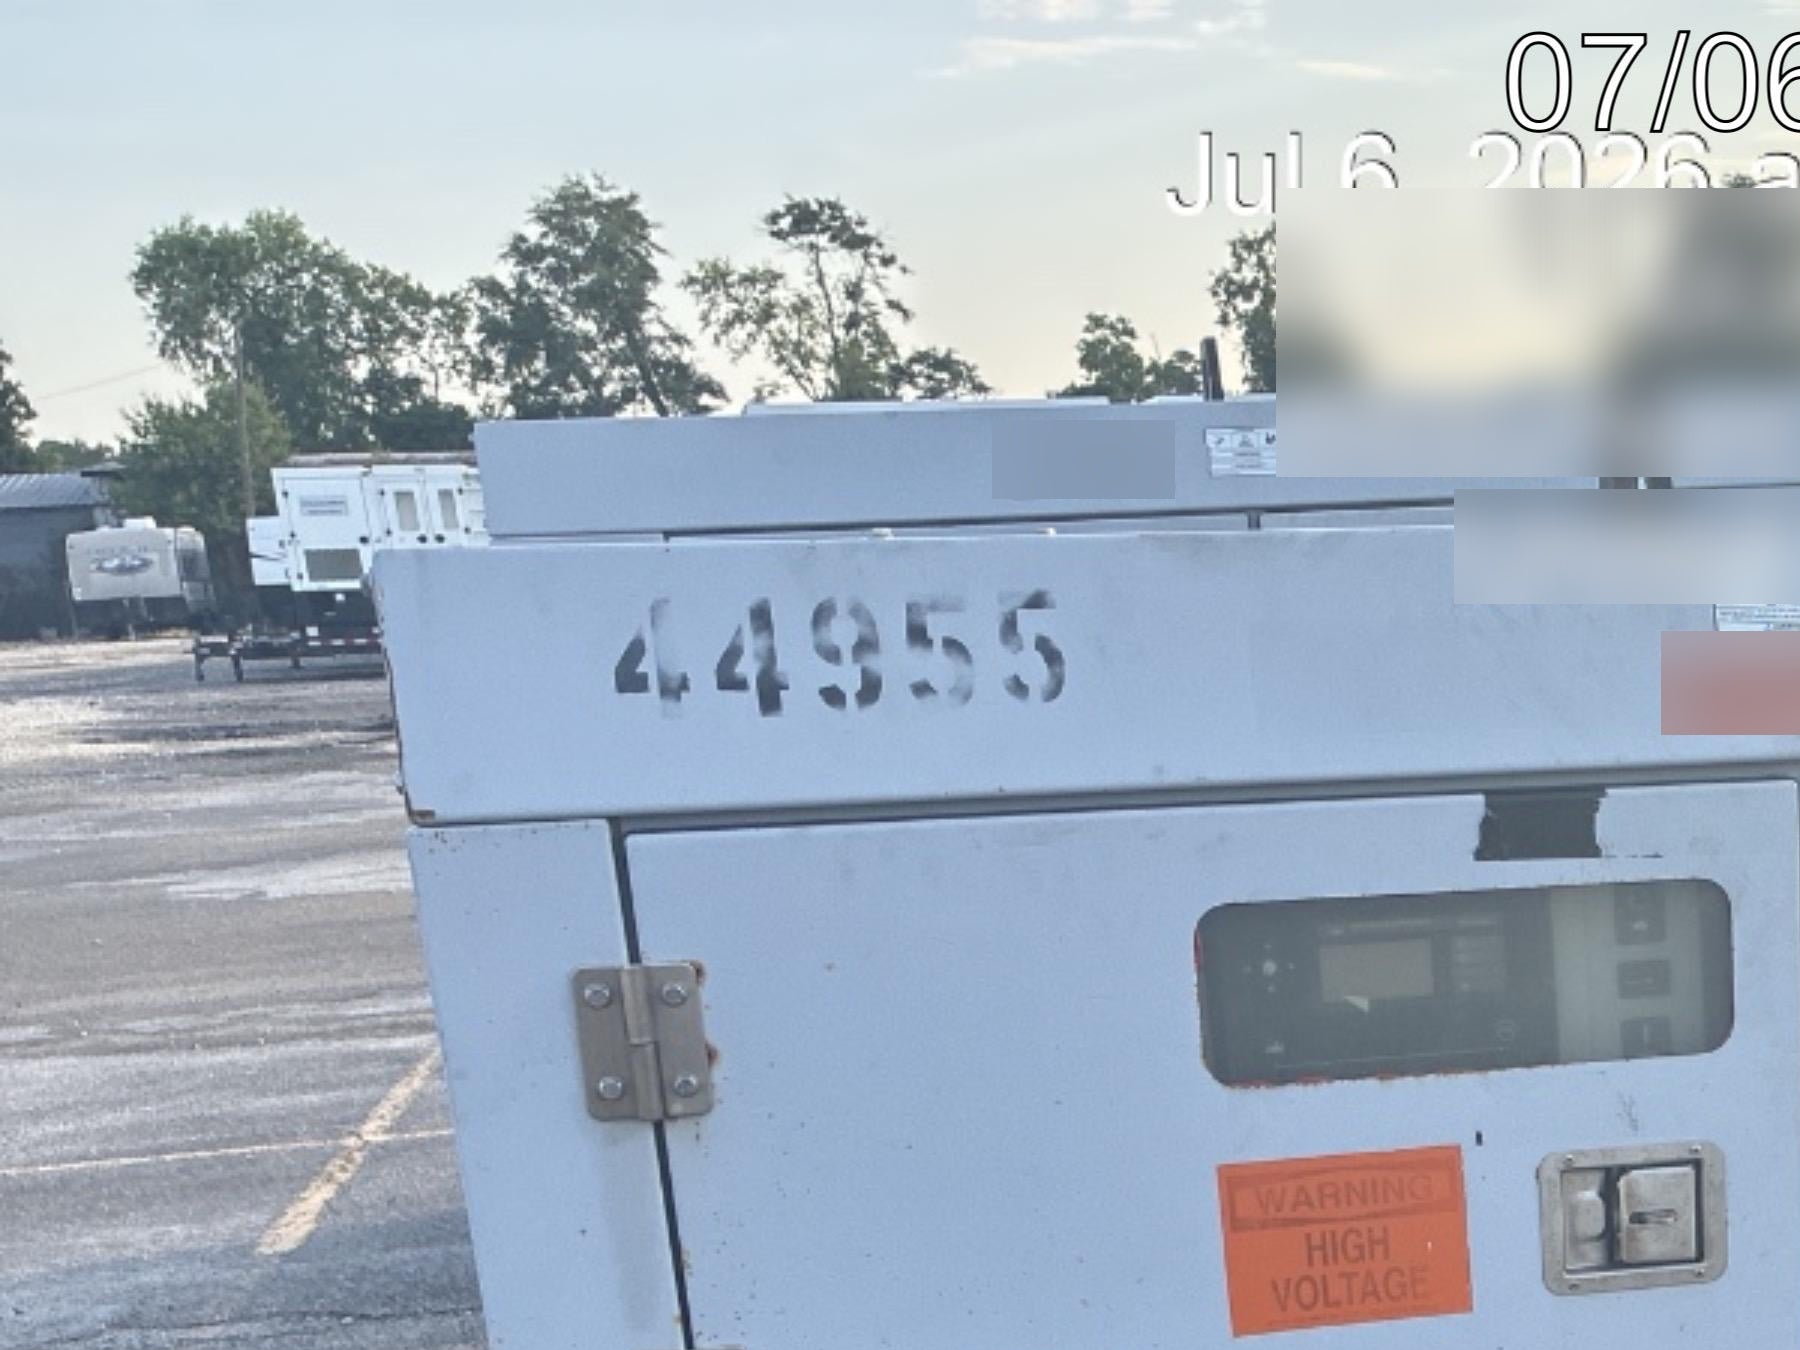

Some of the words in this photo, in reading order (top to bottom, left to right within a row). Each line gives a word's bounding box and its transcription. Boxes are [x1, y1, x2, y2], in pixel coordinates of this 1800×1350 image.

[613, 590, 1066, 717] 44955
[1256, 1174, 1434, 1216] WARNING
[1305, 1226, 1390, 1267] HIGH
[1271, 1264, 1429, 1313] VOLTAGE
